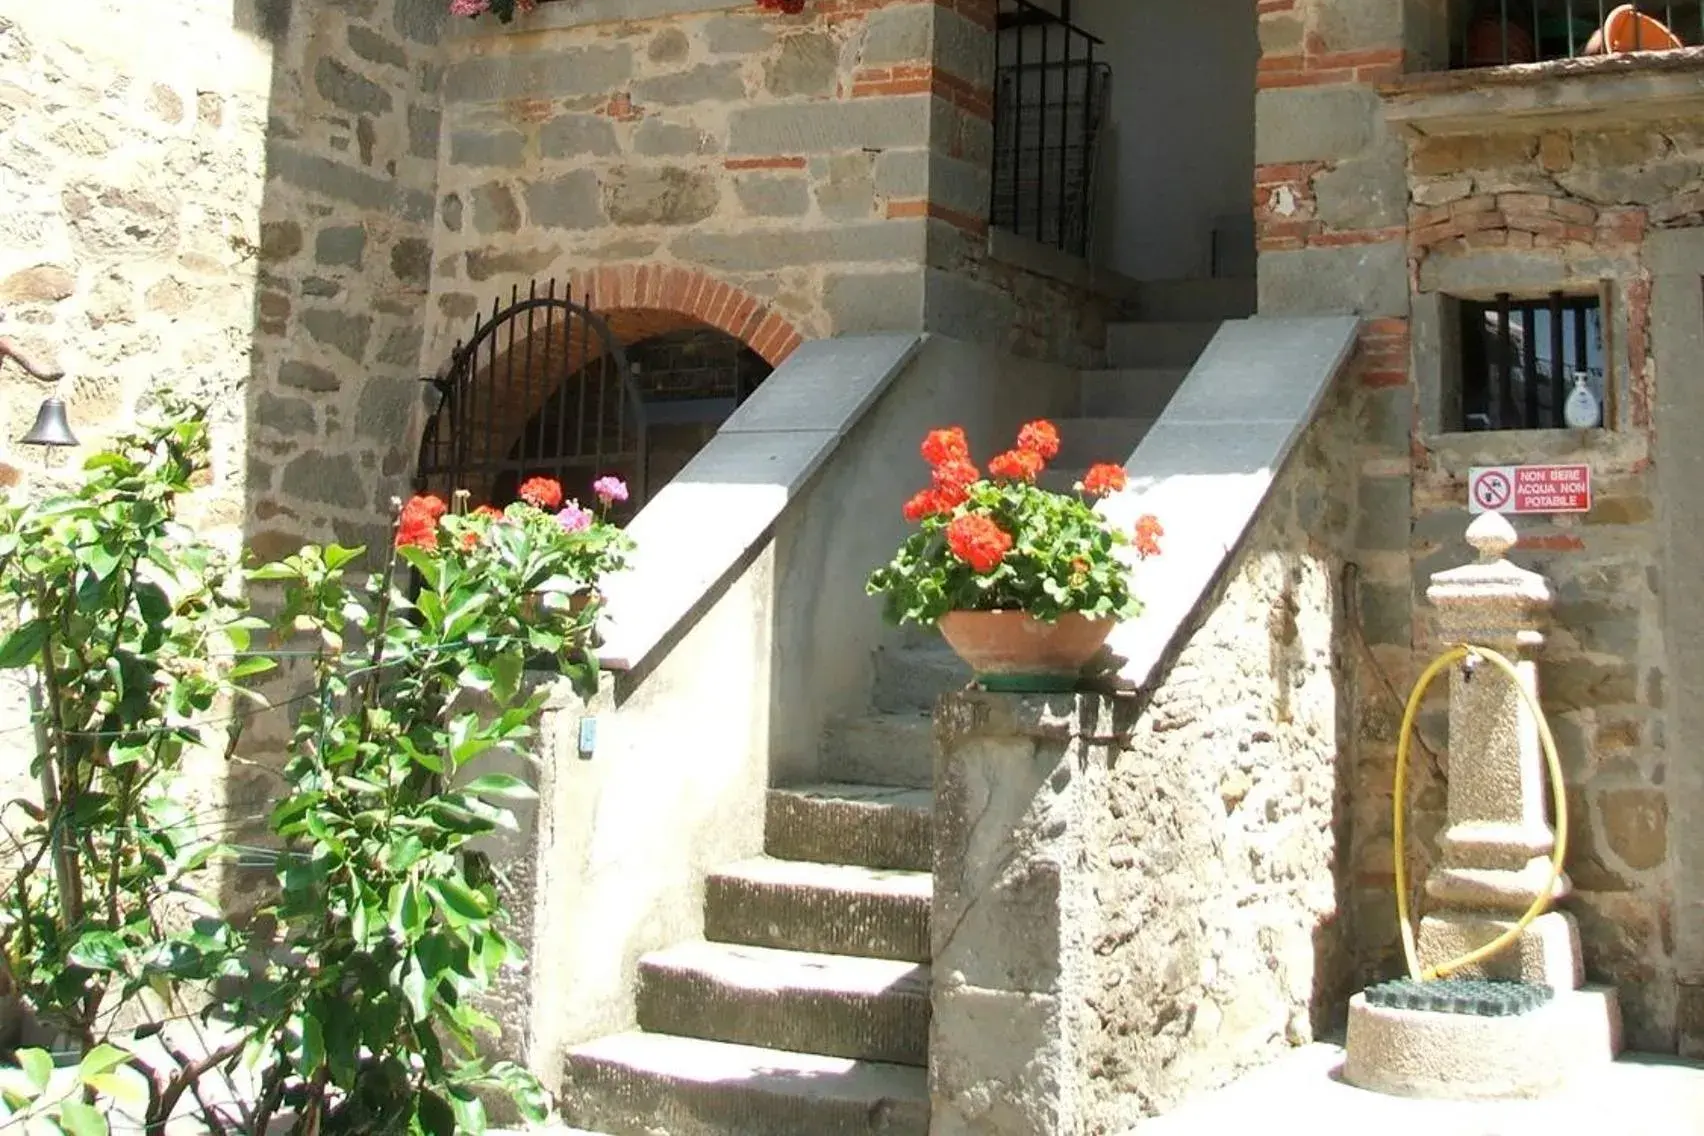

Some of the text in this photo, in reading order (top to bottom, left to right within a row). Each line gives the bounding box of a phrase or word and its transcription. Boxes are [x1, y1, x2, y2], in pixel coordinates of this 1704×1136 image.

[1520, 469, 1580, 481] NON BERE
[1517, 482, 1585, 494] ACQUA NON
[1525, 495, 1577, 507] POTABILE
